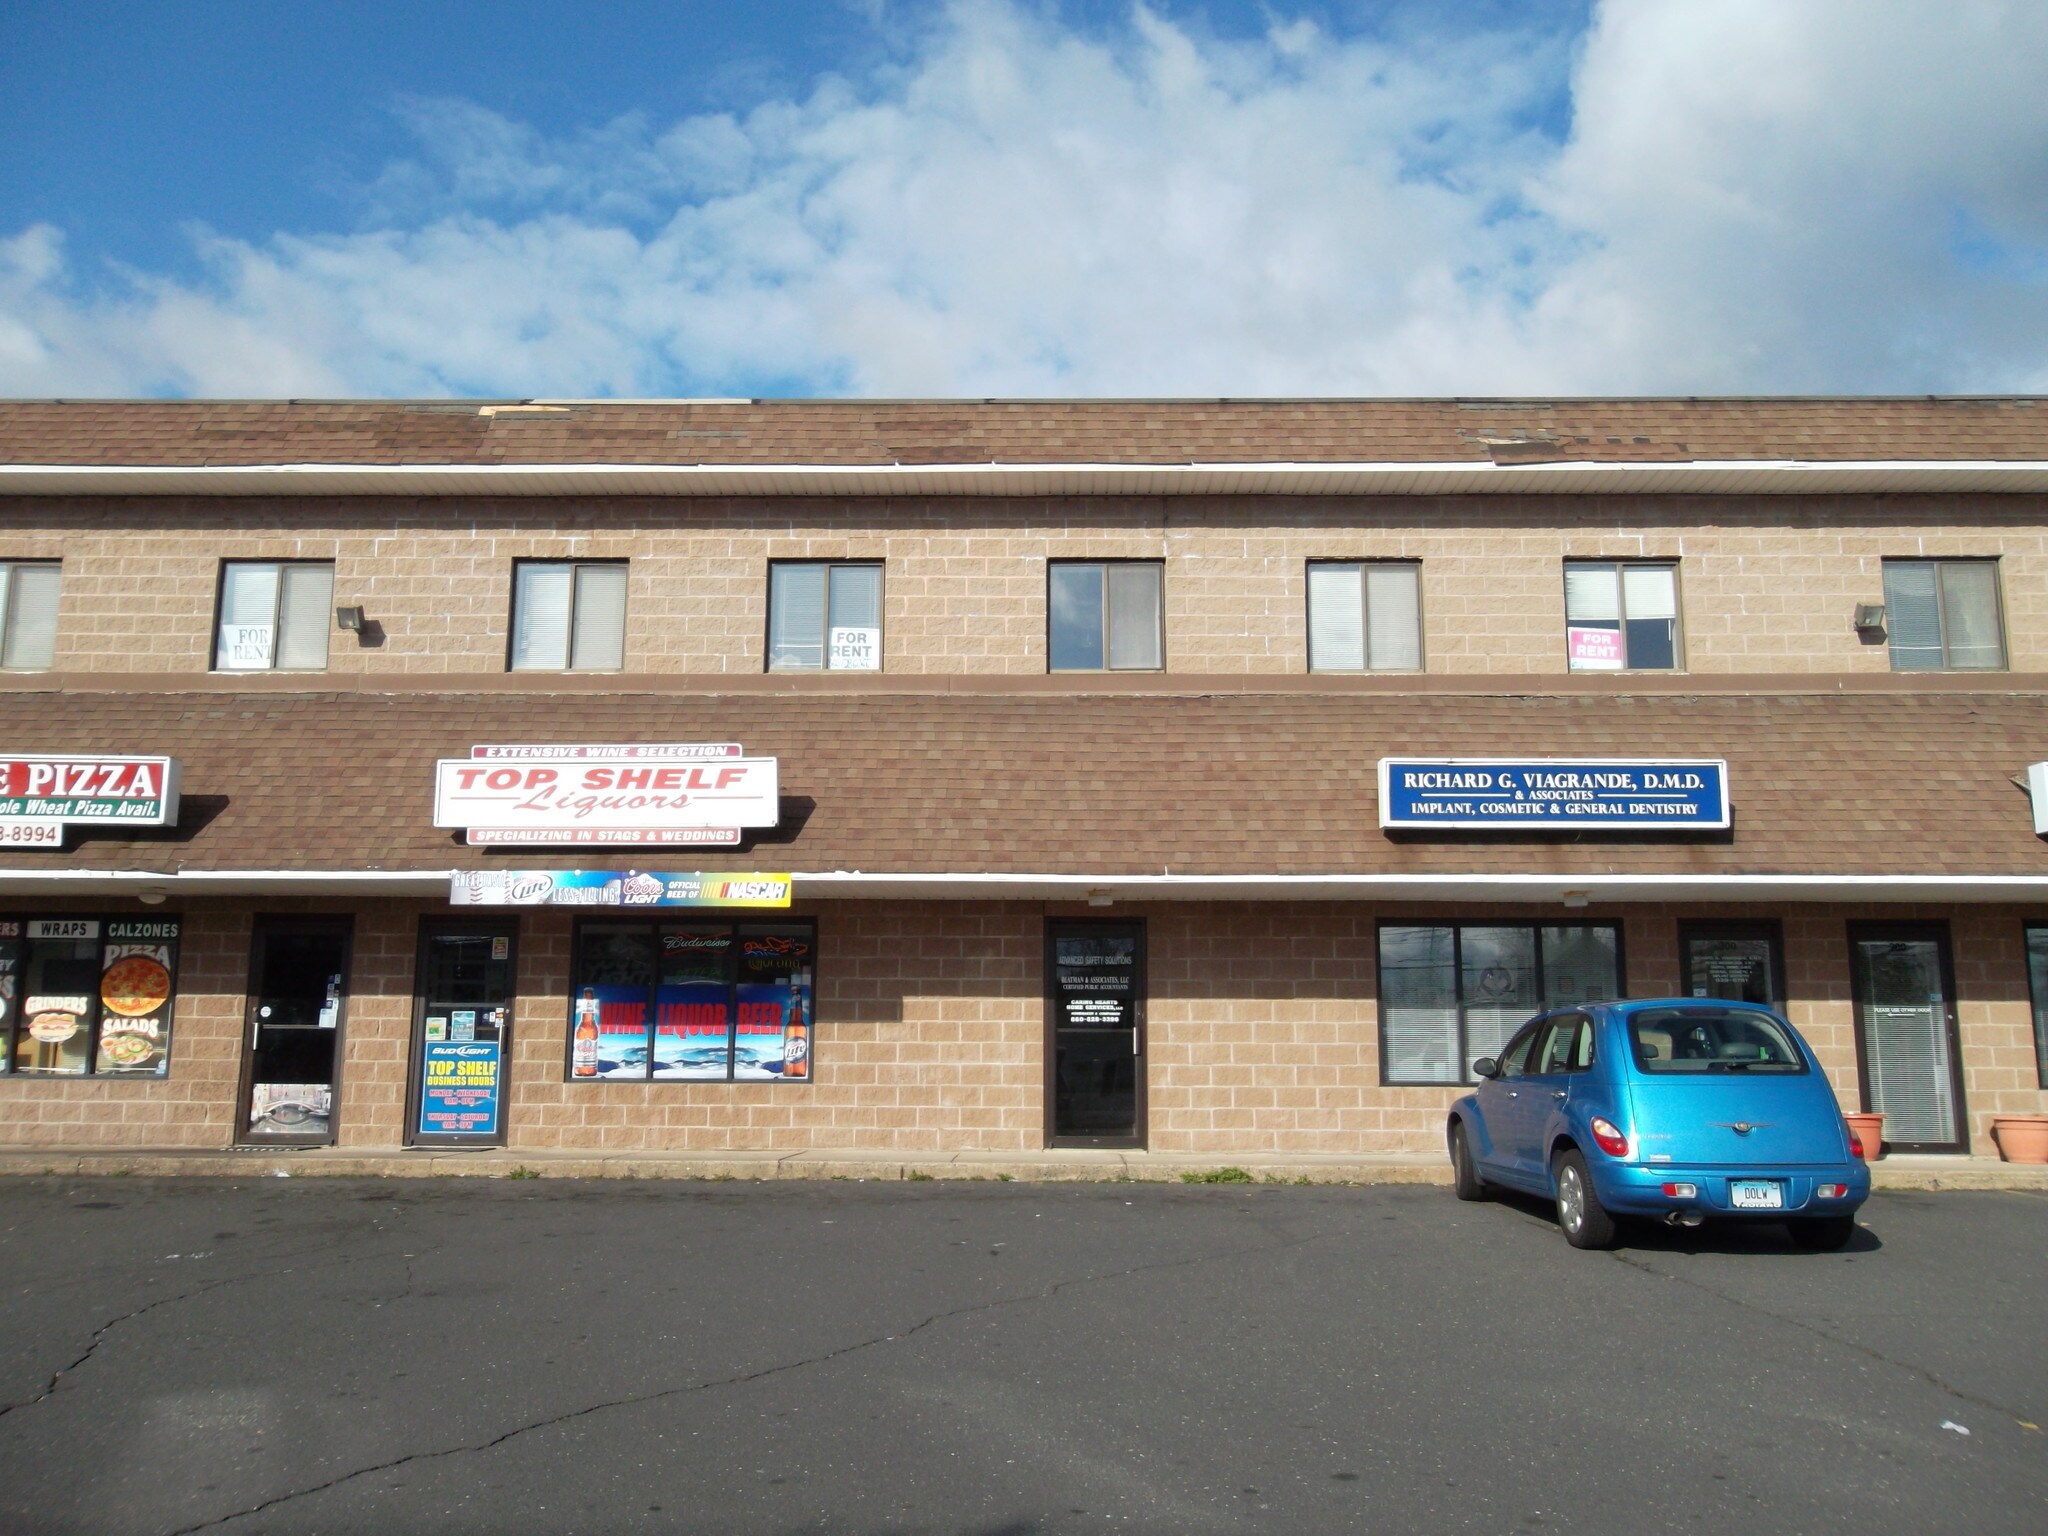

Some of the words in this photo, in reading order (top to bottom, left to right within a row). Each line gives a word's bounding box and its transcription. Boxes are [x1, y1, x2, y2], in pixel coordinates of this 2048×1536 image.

[239, 629, 268, 643] FOR
[837, 632, 867, 643] FOR
[1582, 633, 1612, 644] FOR
[234, 645, 271, 659] RENT
[832, 646, 872, 657] RENT
[1576, 645, 1617, 657] RENT
[486, 747, 579, 757] EXTENSIVE
[586, 747, 629, 757] WINE
[636, 746, 728, 757] SELECTION
[25, 763, 157, 797] PIZZA
[456, 769, 558, 790] TOP
[581, 768, 749, 790] SHELF
[1404, 773, 1492, 788] RICHARD
[1498, 773, 1517, 788] G.
[1523, 773, 1638, 790] VIAGRANDE,
[1643, 773, 1705, 789] D.M.D.
[1514, 789, 1525, 800] &
[1528, 790, 1594, 800] ASSOCIATES
[25, 800, 71, 815] Wheat
[73, 800, 113, 816] Pizza
[116, 801, 156, 817] Avail.
[512, 785, 692, 819] Liquors
[1411, 803, 1476, 815] IMPLANT,
[1479, 803, 1545, 814] COSMETIC
[1549, 803, 1561, 814] &
[1565, 803, 1625, 814] GENERAL
[1629, 803, 1698, 815] DENTISTRY
[476, 830, 573, 842] SPECIALIZING
[577, 831, 592, 841] IN
[597, 831, 641, 841] STAGS
[646, 831, 657, 841] &
[661, 830, 735, 841] WEDDINGS
[454, 873, 481, 887] GREAT
[623, 877, 665, 896] Coors
[669, 881, 700, 889] OFFICIAL
[552, 887, 575, 902] LESS
[667, 890, 688, 898] BEER
[688, 890, 700, 898] OF
[728, 882, 787, 899] NASCAR
[624, 894, 662, 904] LIGHT
[41, 922, 87, 935] WRAPS
[108, 923, 179, 937] CALZONES
[663, 936, 732, 949] Budweiser
[103, 944, 171, 971] PIZZA
[26, 996, 88, 1016] GRINDERS
[600, 1002, 647, 1035] WINE
[657, 1003, 728, 1039] LIQUOR
[737, 1003, 783, 1036] BEER
[102, 1018, 159, 1038] SALADS
[432, 1047, 458, 1055] BUD
[461, 1047, 492, 1055] LIGHT
[428, 1061, 455, 1076] TOP
[457, 1061, 497, 1076] SHELF
[427, 1076, 466, 1086] BUSINESS
[467, 1076, 495, 1086] HOURS
